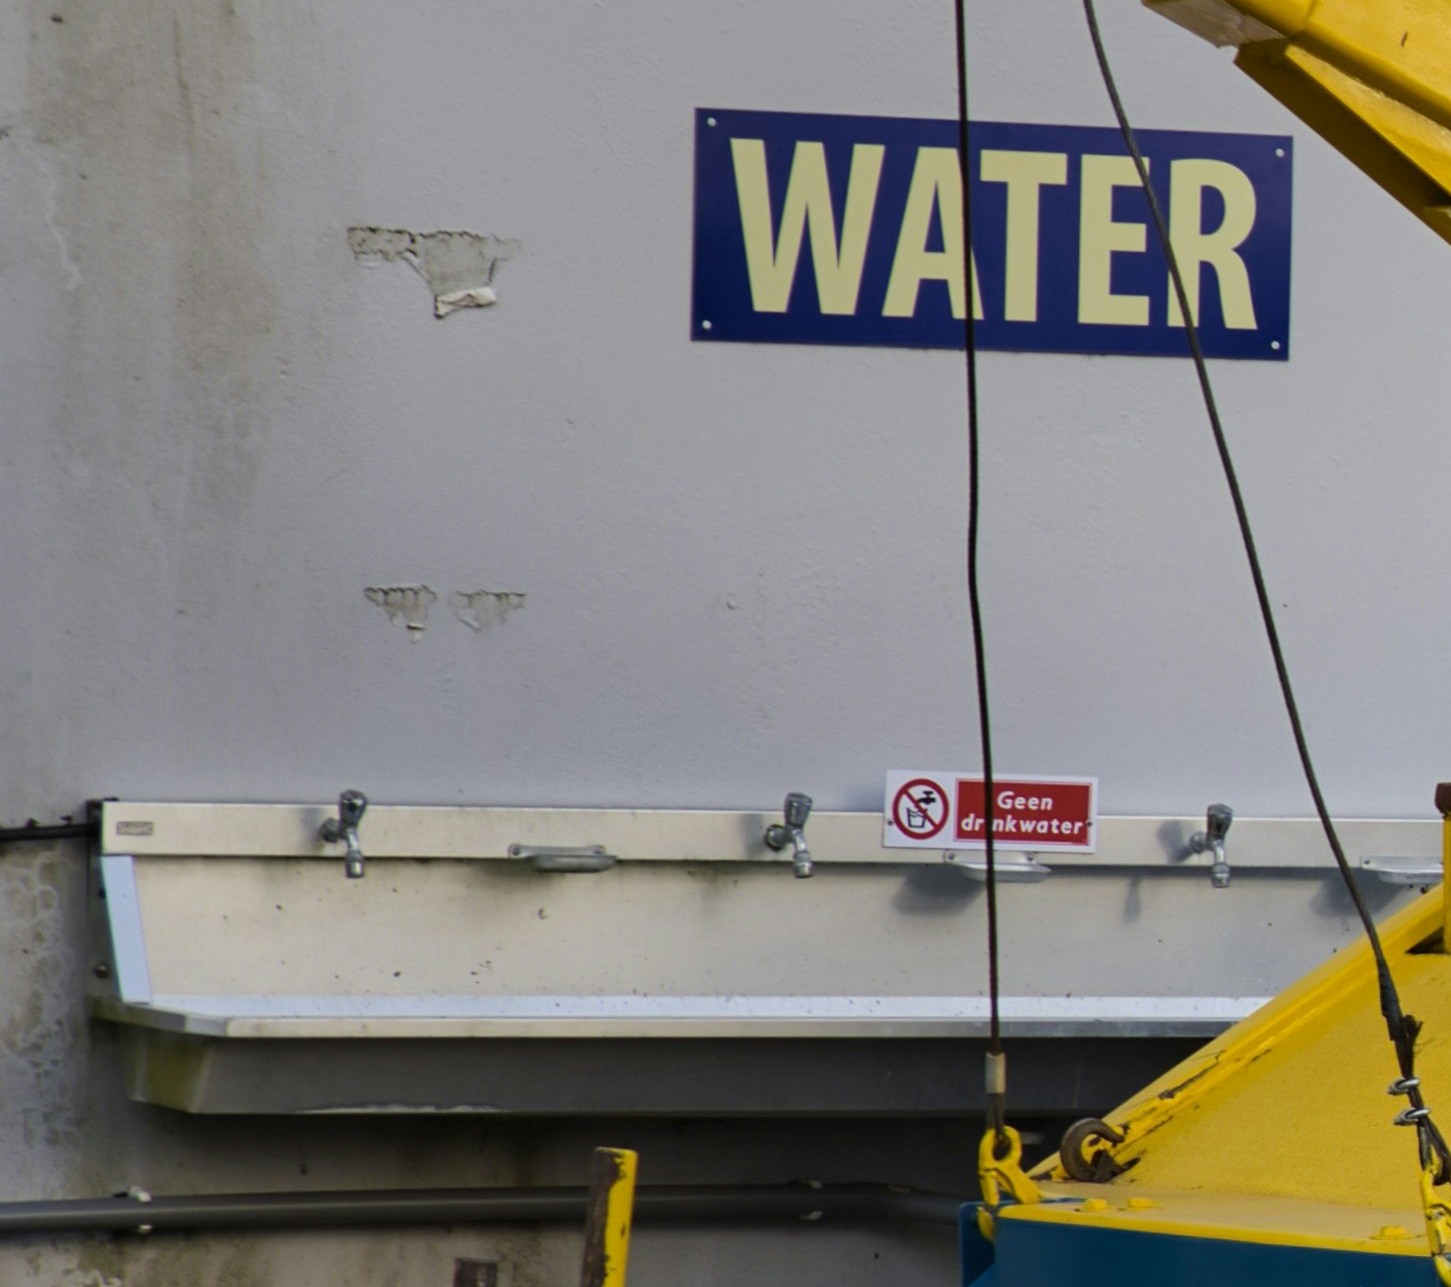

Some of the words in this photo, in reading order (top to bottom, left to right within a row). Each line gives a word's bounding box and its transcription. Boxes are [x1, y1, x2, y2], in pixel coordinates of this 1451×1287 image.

[730, 138, 1258, 330] WATER
[997, 790, 1053, 811] Geen
[961, 813, 1083, 835] drnkwater
